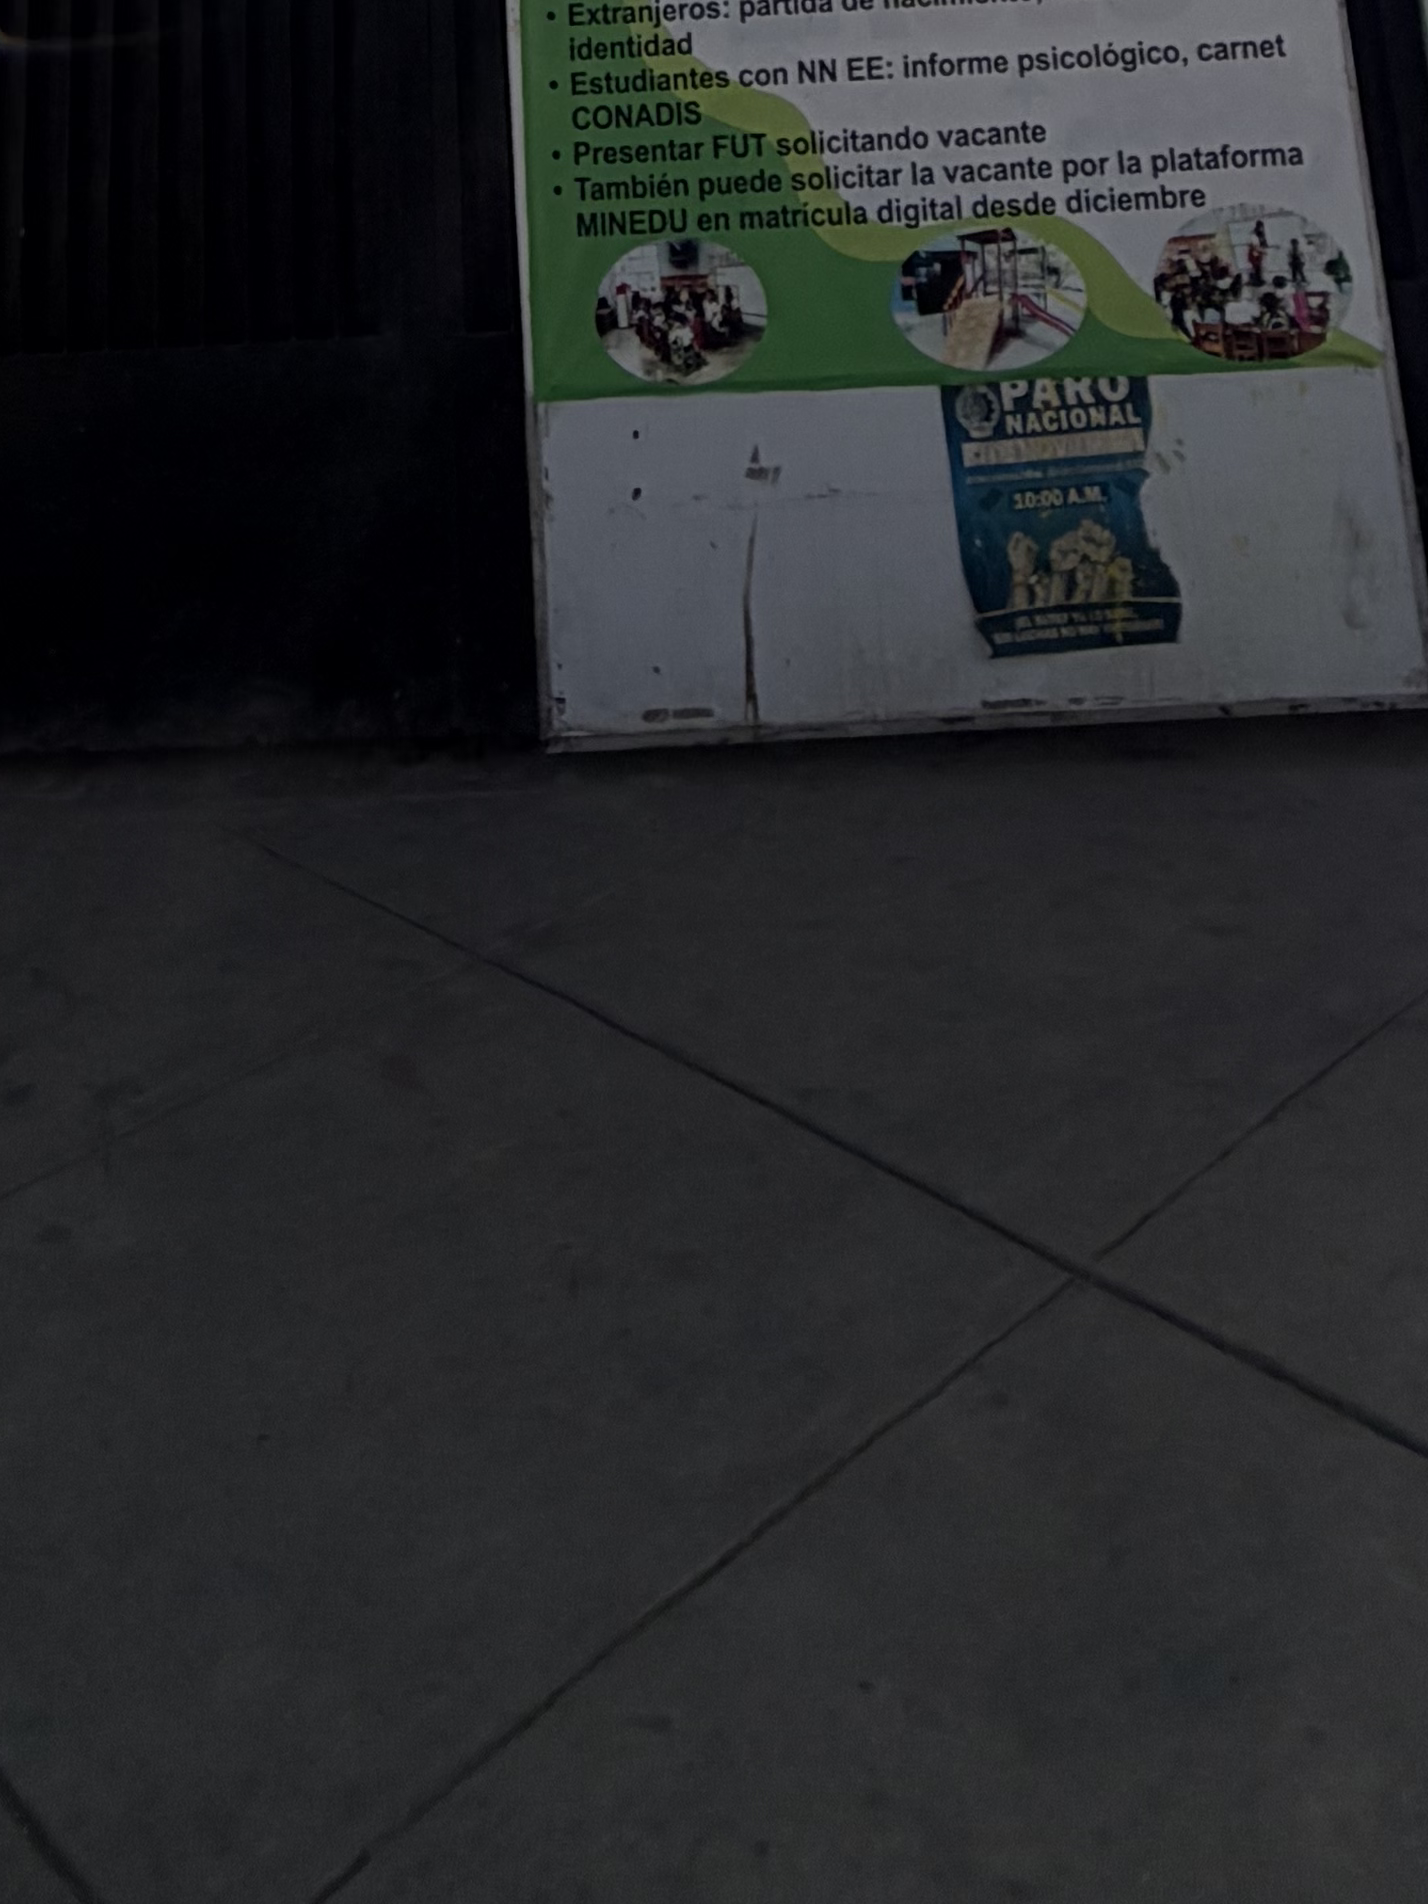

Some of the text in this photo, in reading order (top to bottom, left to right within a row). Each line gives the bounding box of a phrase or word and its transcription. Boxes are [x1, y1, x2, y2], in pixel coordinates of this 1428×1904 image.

[568, 0, 729, 27] Extranjeros:
[569, 33, 692, 61] identidad
[570, 34, 1287, 96] Estudiantes con NN EE: informe psicológico, carnet
[572, 101, 701, 130] CONADIS
[574, 121, 1047, 165] Presentar FUT solicitando vacante
[574, 144, 1304, 201] También puede solicitar la vacante por la plataforma
[576, 186, 1206, 237] MINEDU en matrícula digital desde diciembre
[999, 376, 1130, 412] PARO
[1005, 402, 1142, 436] NACIONAL
